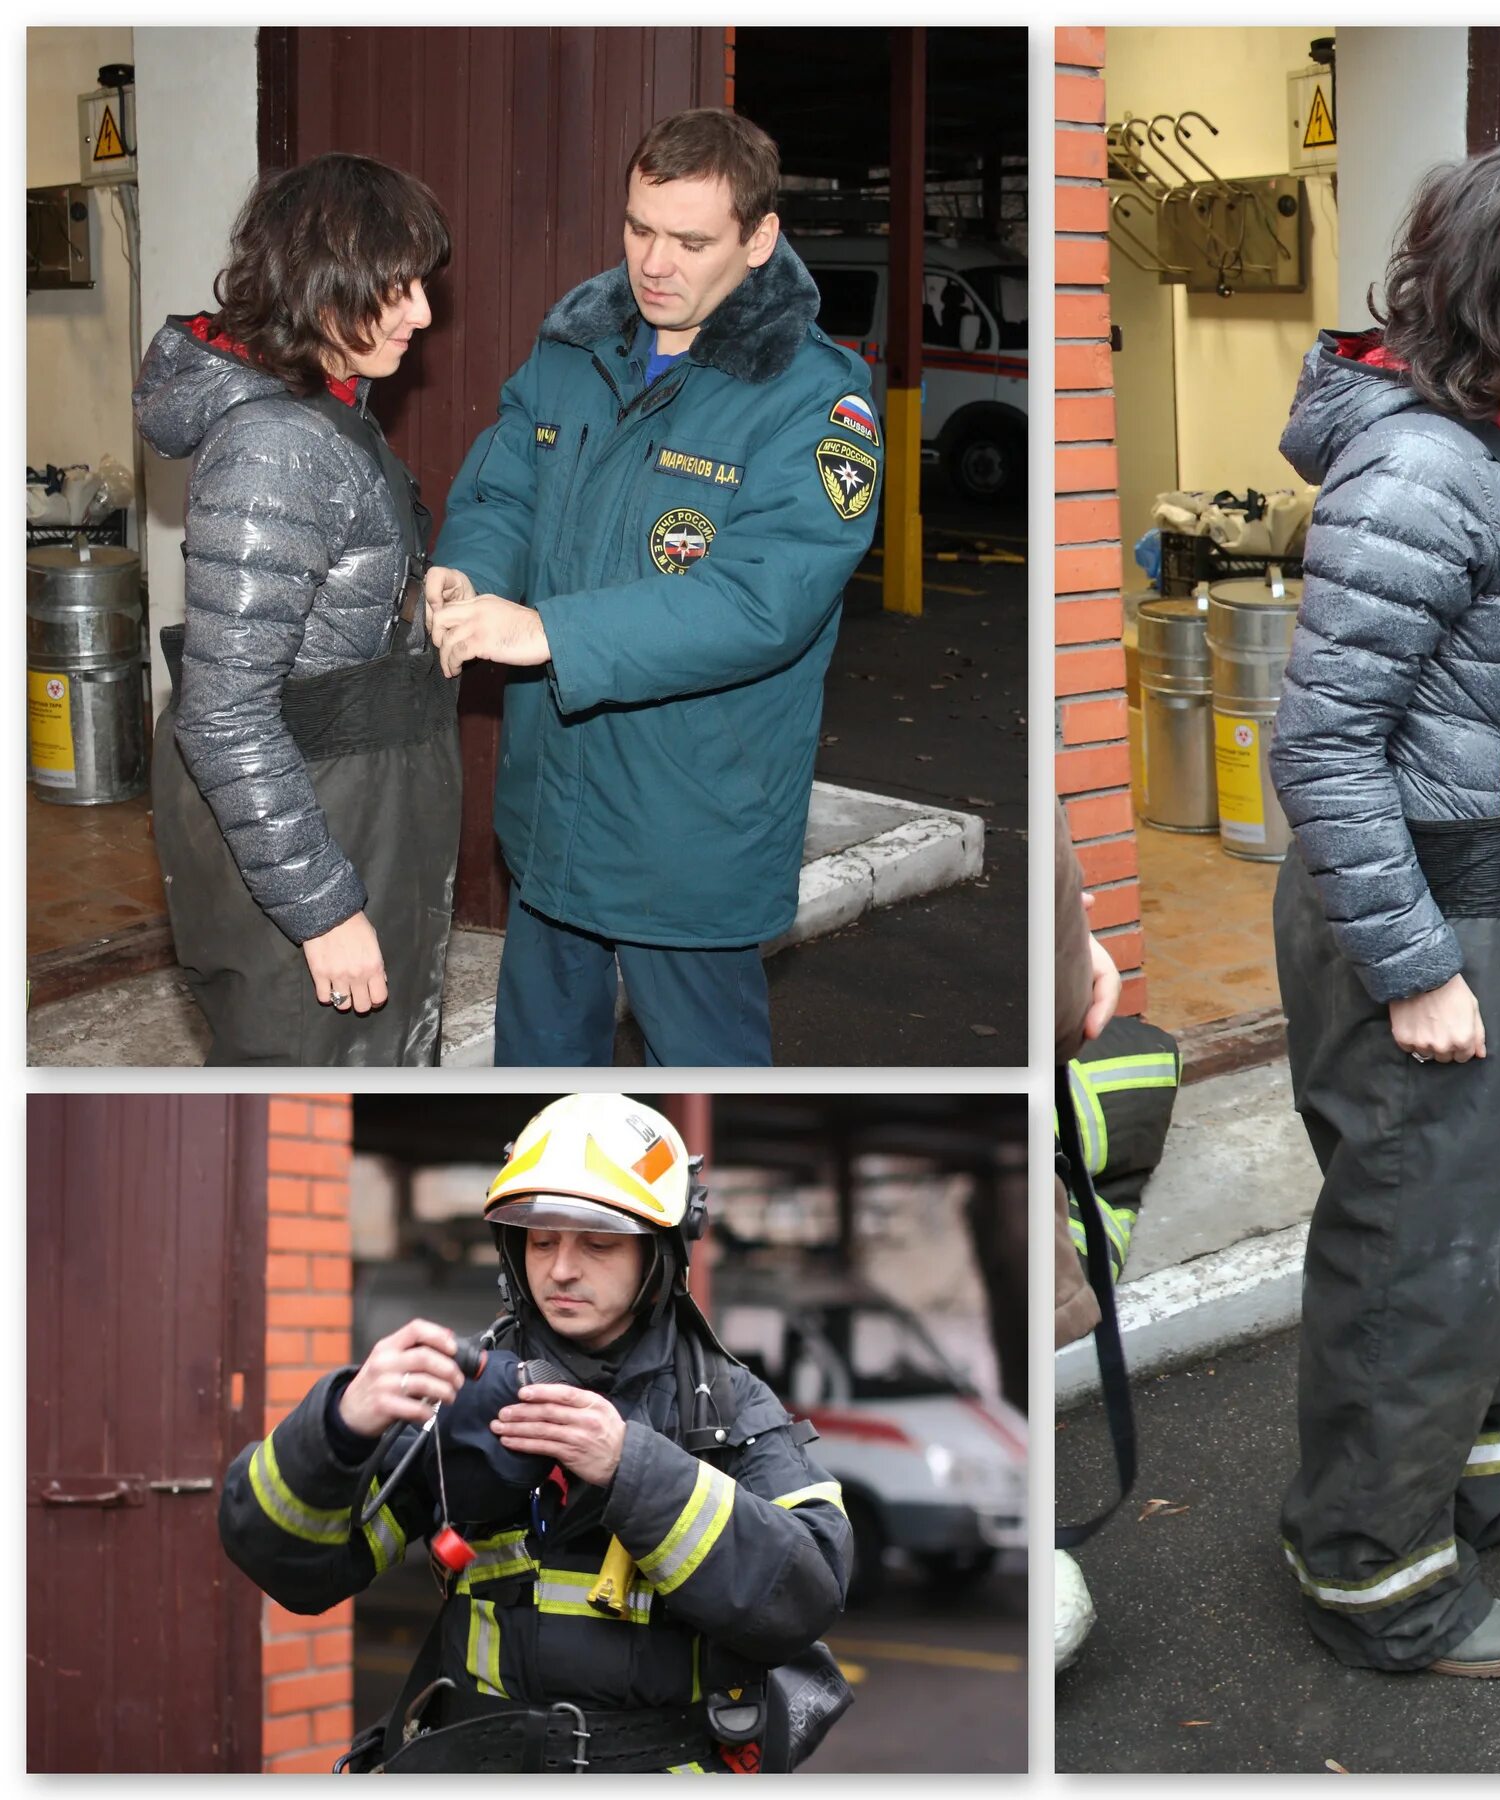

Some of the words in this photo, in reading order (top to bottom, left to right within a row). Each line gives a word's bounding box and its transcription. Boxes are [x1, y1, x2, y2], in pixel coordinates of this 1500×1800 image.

[843, 416, 872, 438] RUSSIA
[660, 450, 713, 477] МАРКЕЛОВ
[715, 464, 739, 484] Д.А.
[823, 442, 840, 452] МЧС
[840, 445, 872, 466] РОССИИ
[656, 515, 676, 536] МЧС
[678, 512, 714, 543] РОССИИ
